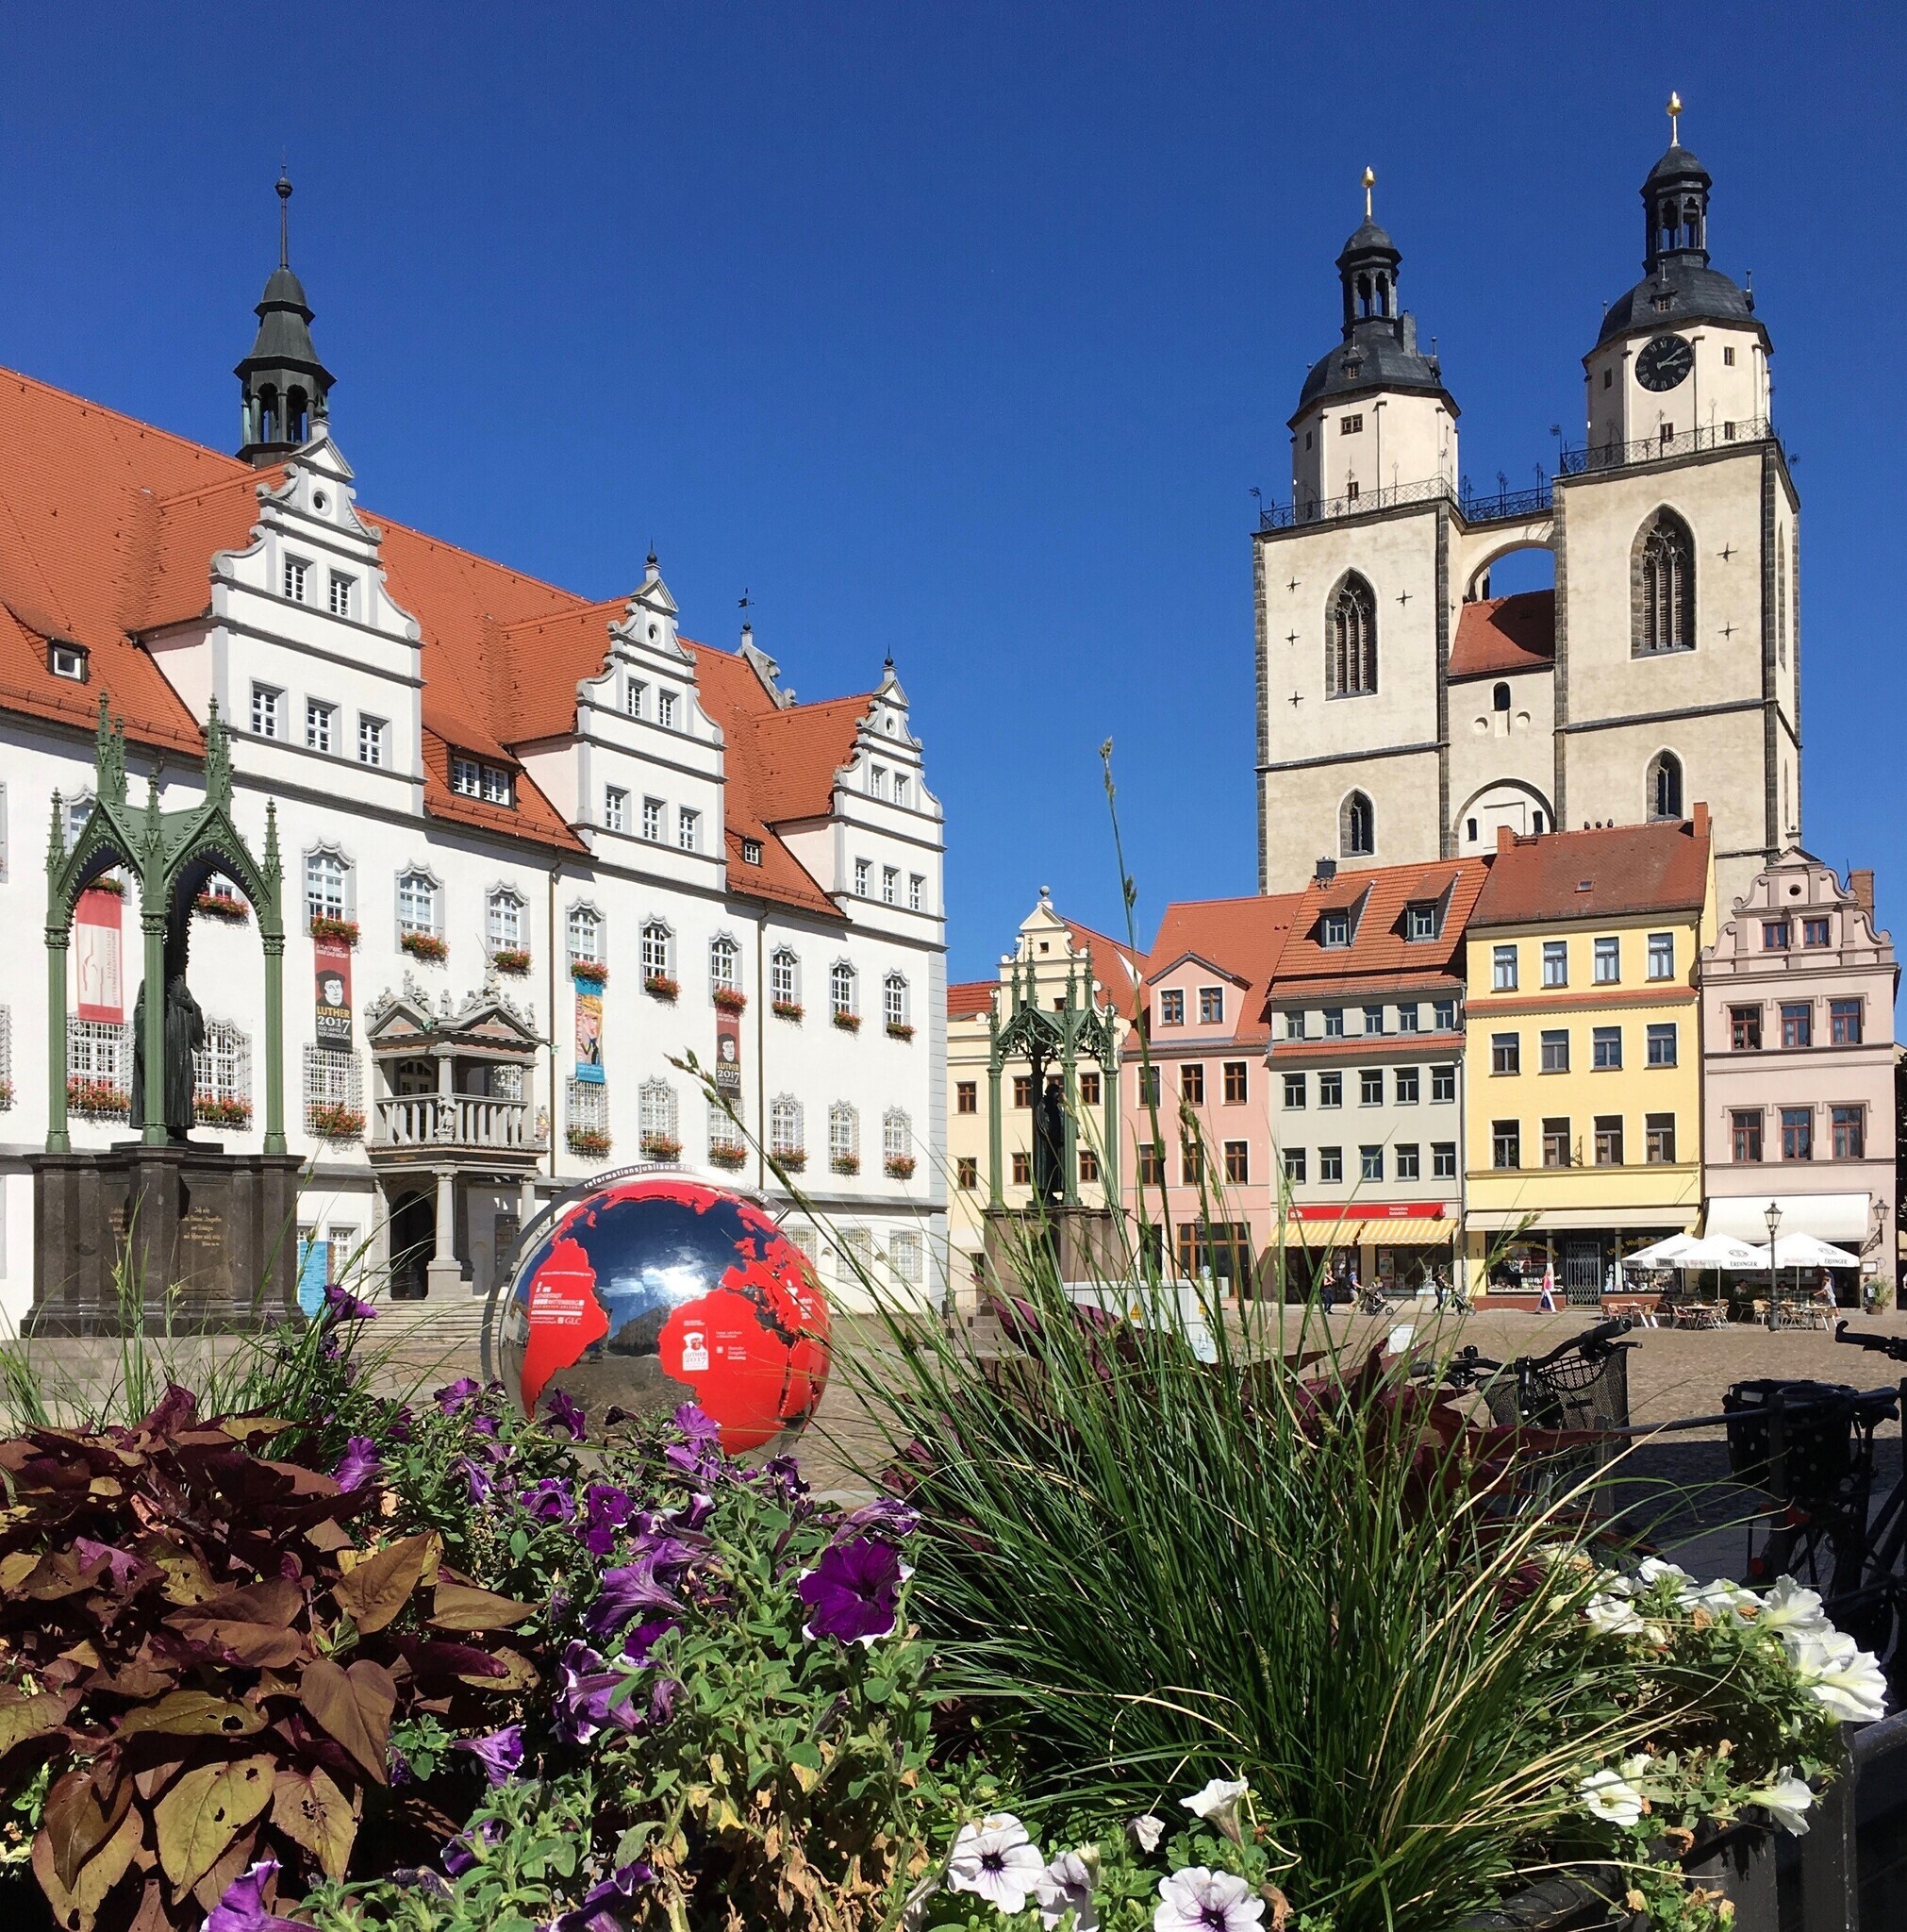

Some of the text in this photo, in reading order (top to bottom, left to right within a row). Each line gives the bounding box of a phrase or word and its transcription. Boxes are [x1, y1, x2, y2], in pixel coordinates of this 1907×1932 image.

[316, 1006, 351, 1019] LUTHER
[317, 1015, 352, 1034] 2017
[717, 1061, 739, 1072] LUTHER
[717, 1070, 740, 1084] 2017
[584, 1163, 677, 1190] reformationsjubiläum
[565, 1316, 582, 1325] GLC
[685, 1357, 706, 1365] 2017
